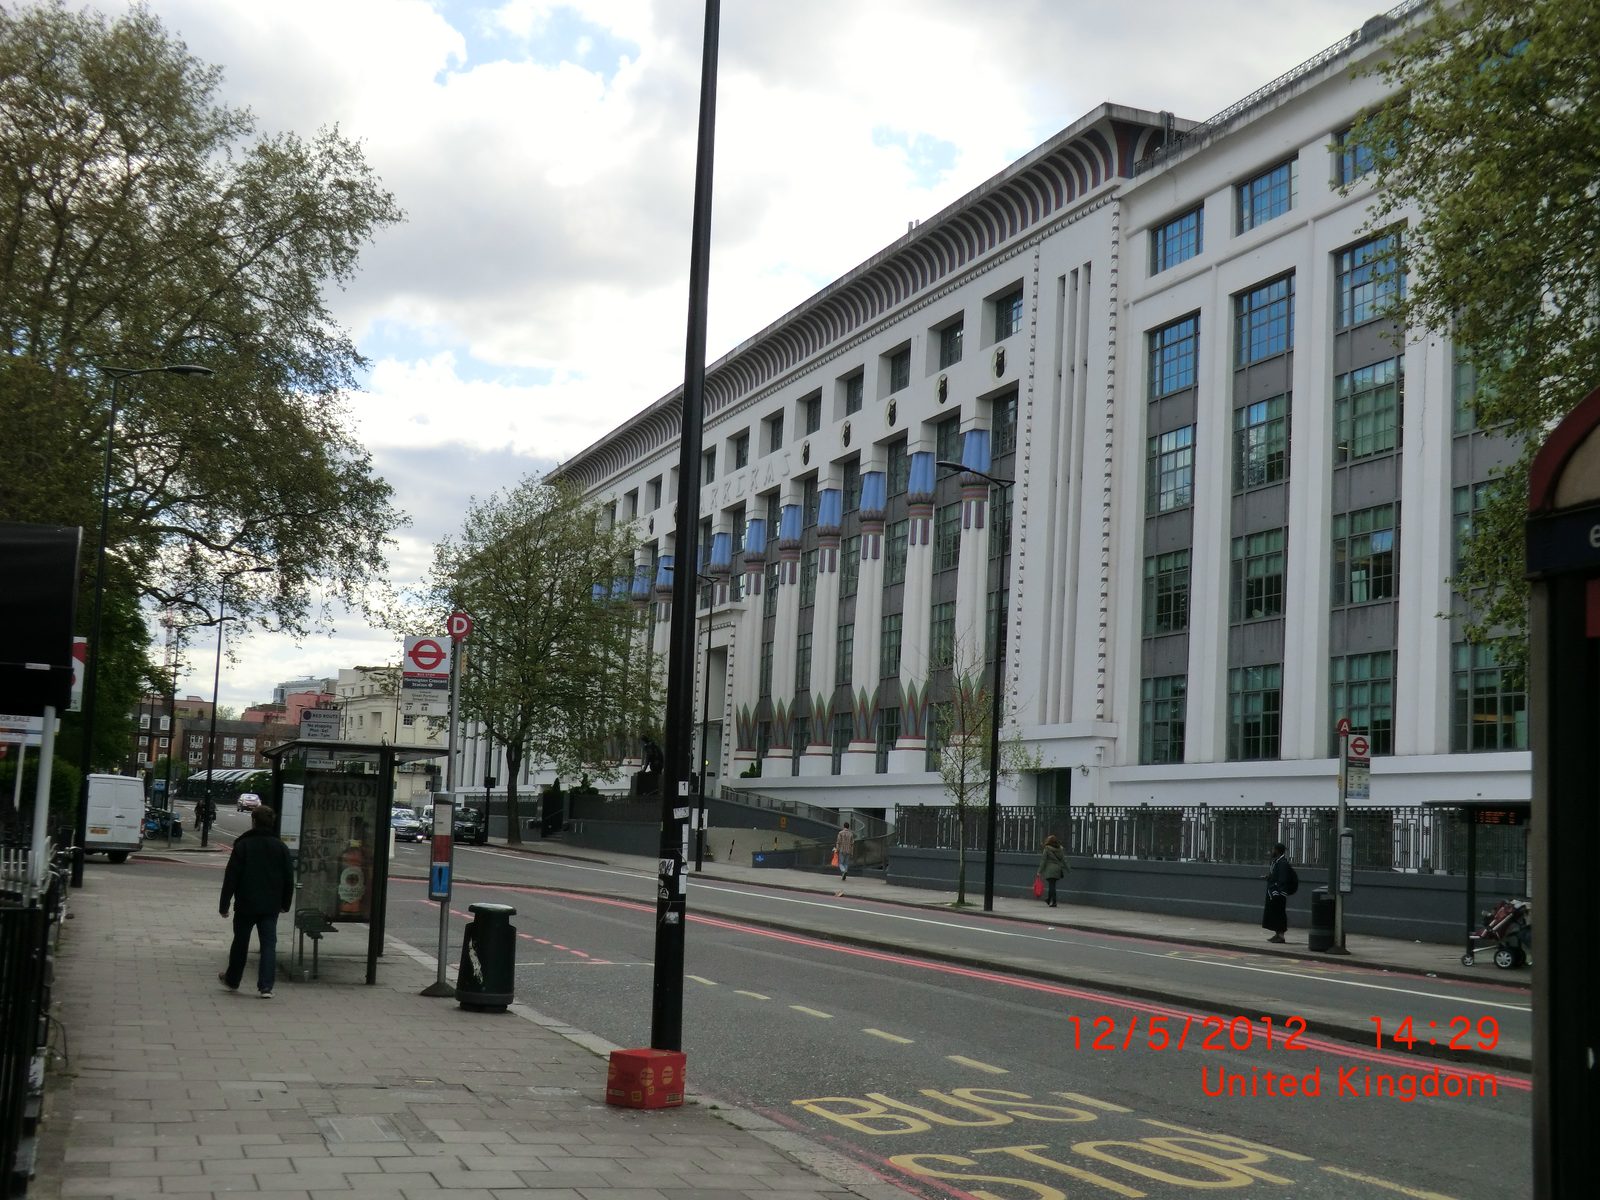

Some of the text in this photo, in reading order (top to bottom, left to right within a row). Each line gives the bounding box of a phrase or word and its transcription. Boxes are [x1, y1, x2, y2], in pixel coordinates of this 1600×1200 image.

[699, 452, 791, 513] ARRERAS
[453, 617, 468, 633] D
[1341, 721, 1349, 732] A
[304, 782, 377, 797] ACARDI
[320, 828, 337, 838] UP
[298, 860, 328, 873] OLA
[792, 1087, 1096, 1135] BUS
[888, 1136, 1297, 1200] STOP
